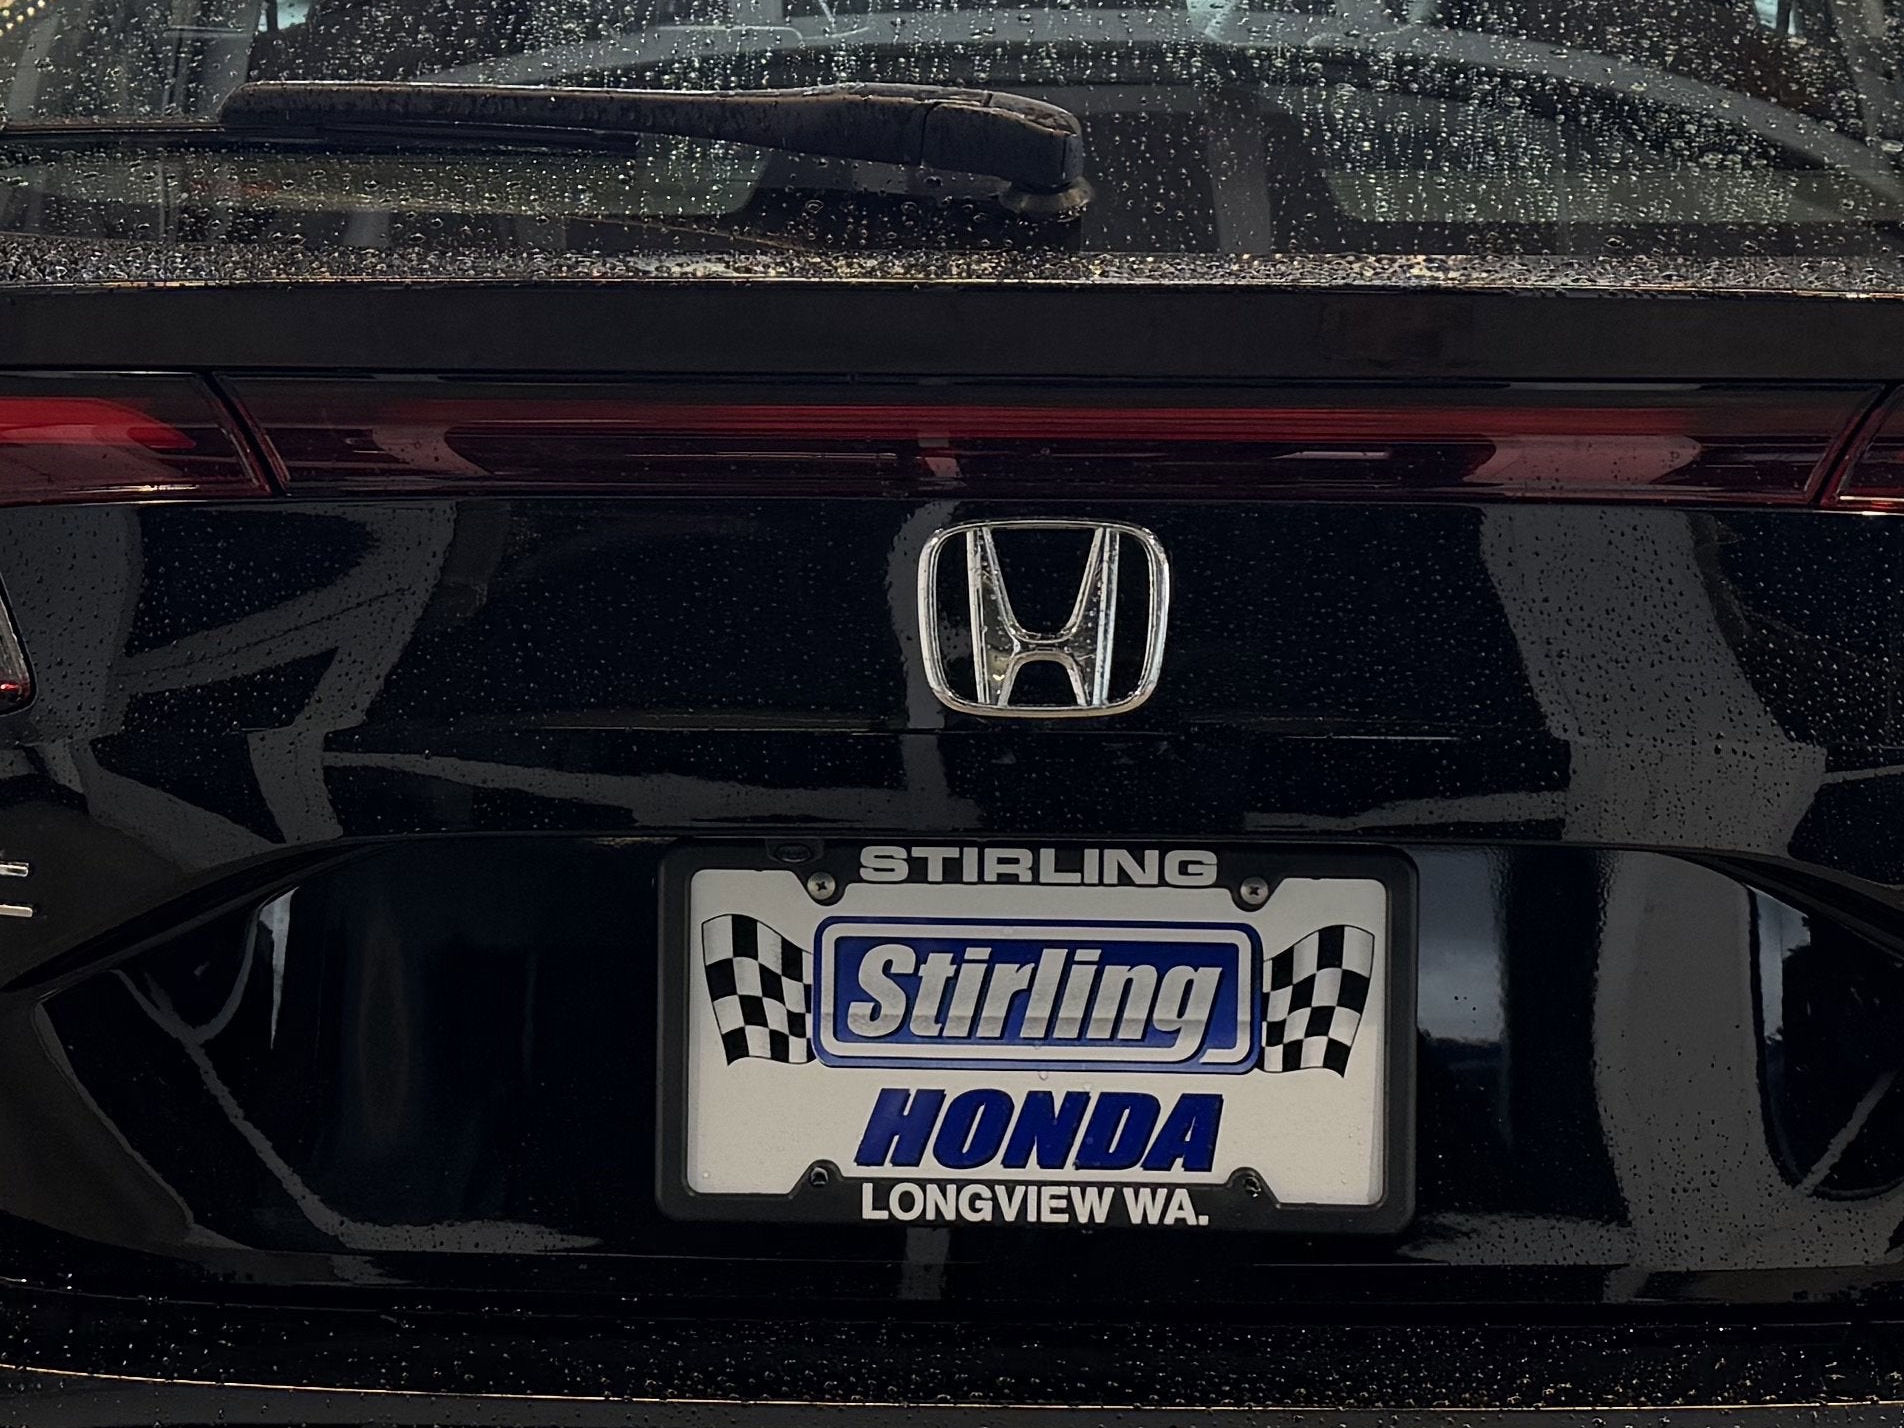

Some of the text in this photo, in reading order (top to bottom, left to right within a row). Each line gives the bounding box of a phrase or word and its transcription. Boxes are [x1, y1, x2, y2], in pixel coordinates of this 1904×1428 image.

[859, 846, 1218, 887] STIRLING
[846, 944, 1222, 1060] Stirling
[853, 1088, 1223, 1172] HONDA
[861, 1182, 1210, 1226] LONGVIEW WA.
